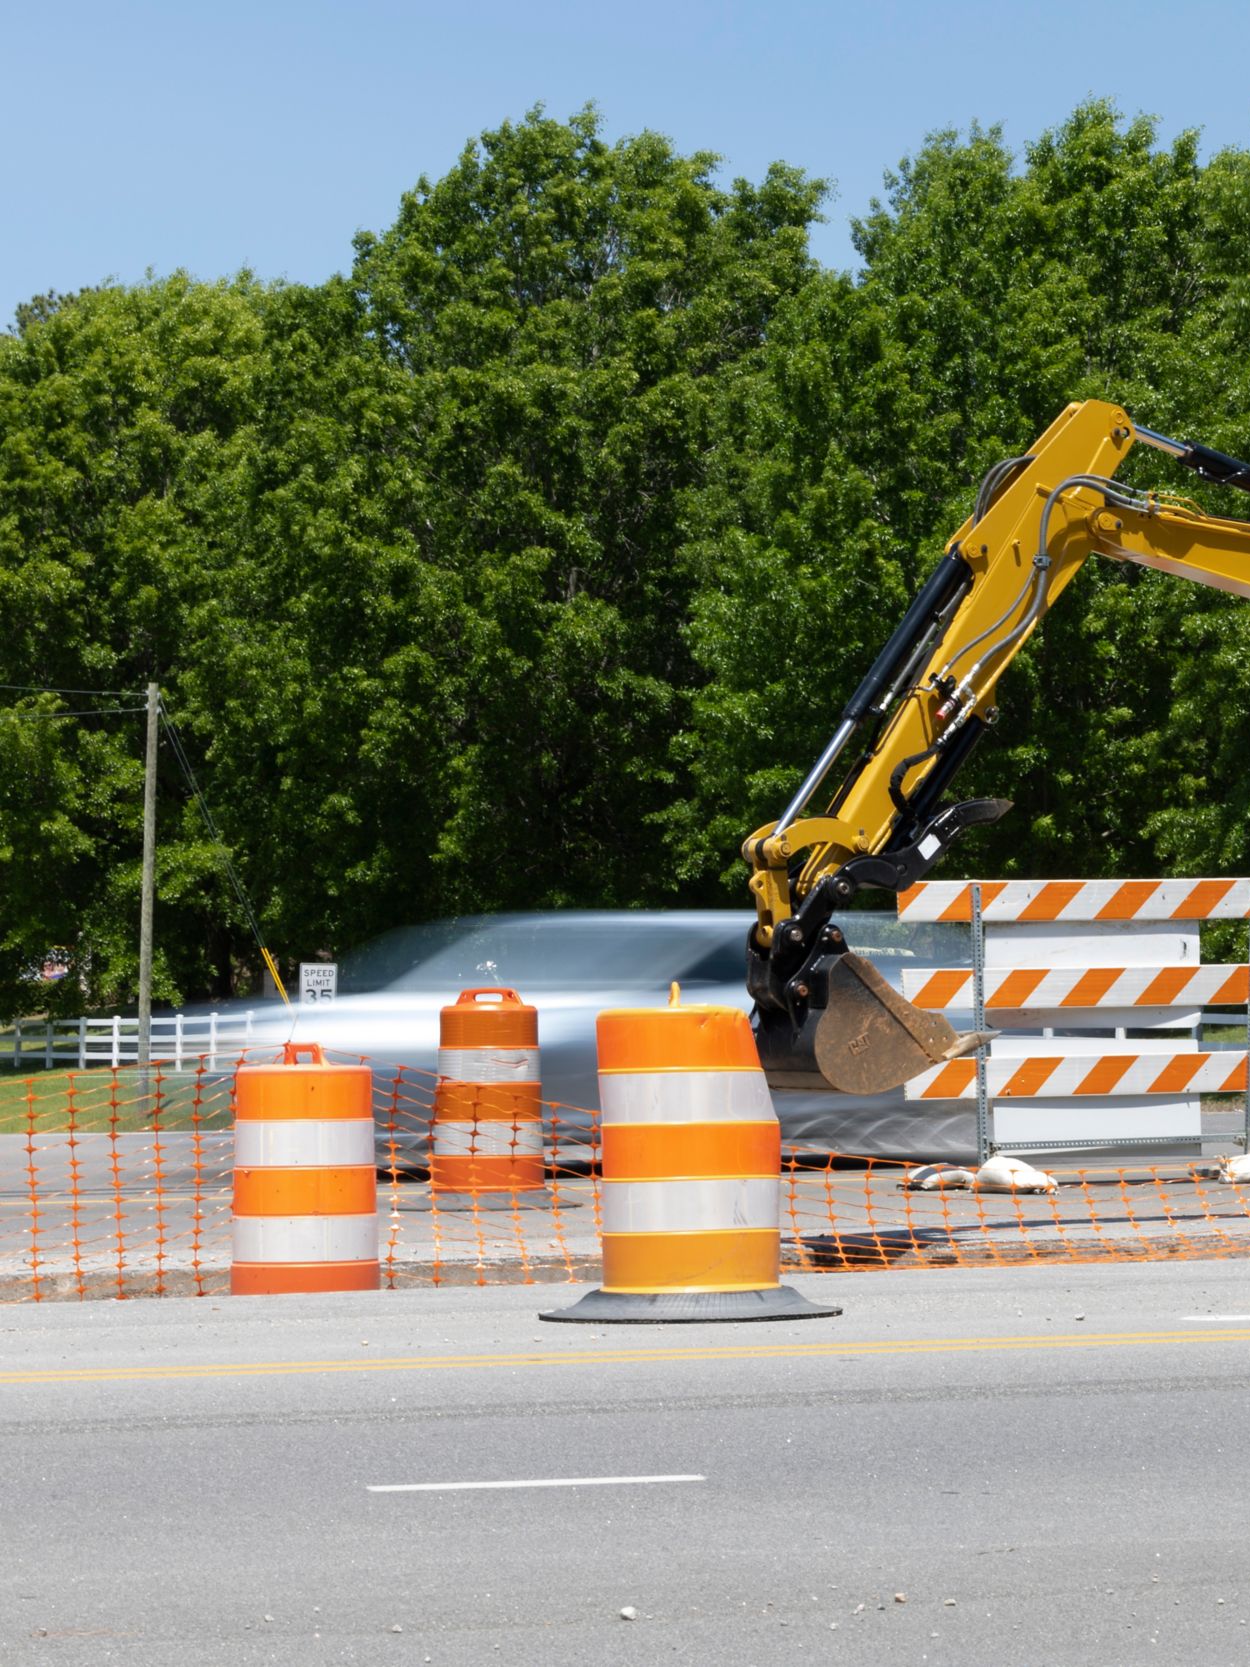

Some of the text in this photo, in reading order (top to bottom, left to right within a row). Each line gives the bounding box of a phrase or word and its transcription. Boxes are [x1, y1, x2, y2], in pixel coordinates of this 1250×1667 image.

[303, 969, 334, 977] SPEED
[306, 979, 331, 987] LIMIT
[305, 989, 333, 1002] 35
[848, 1032, 871, 1056] CAT
